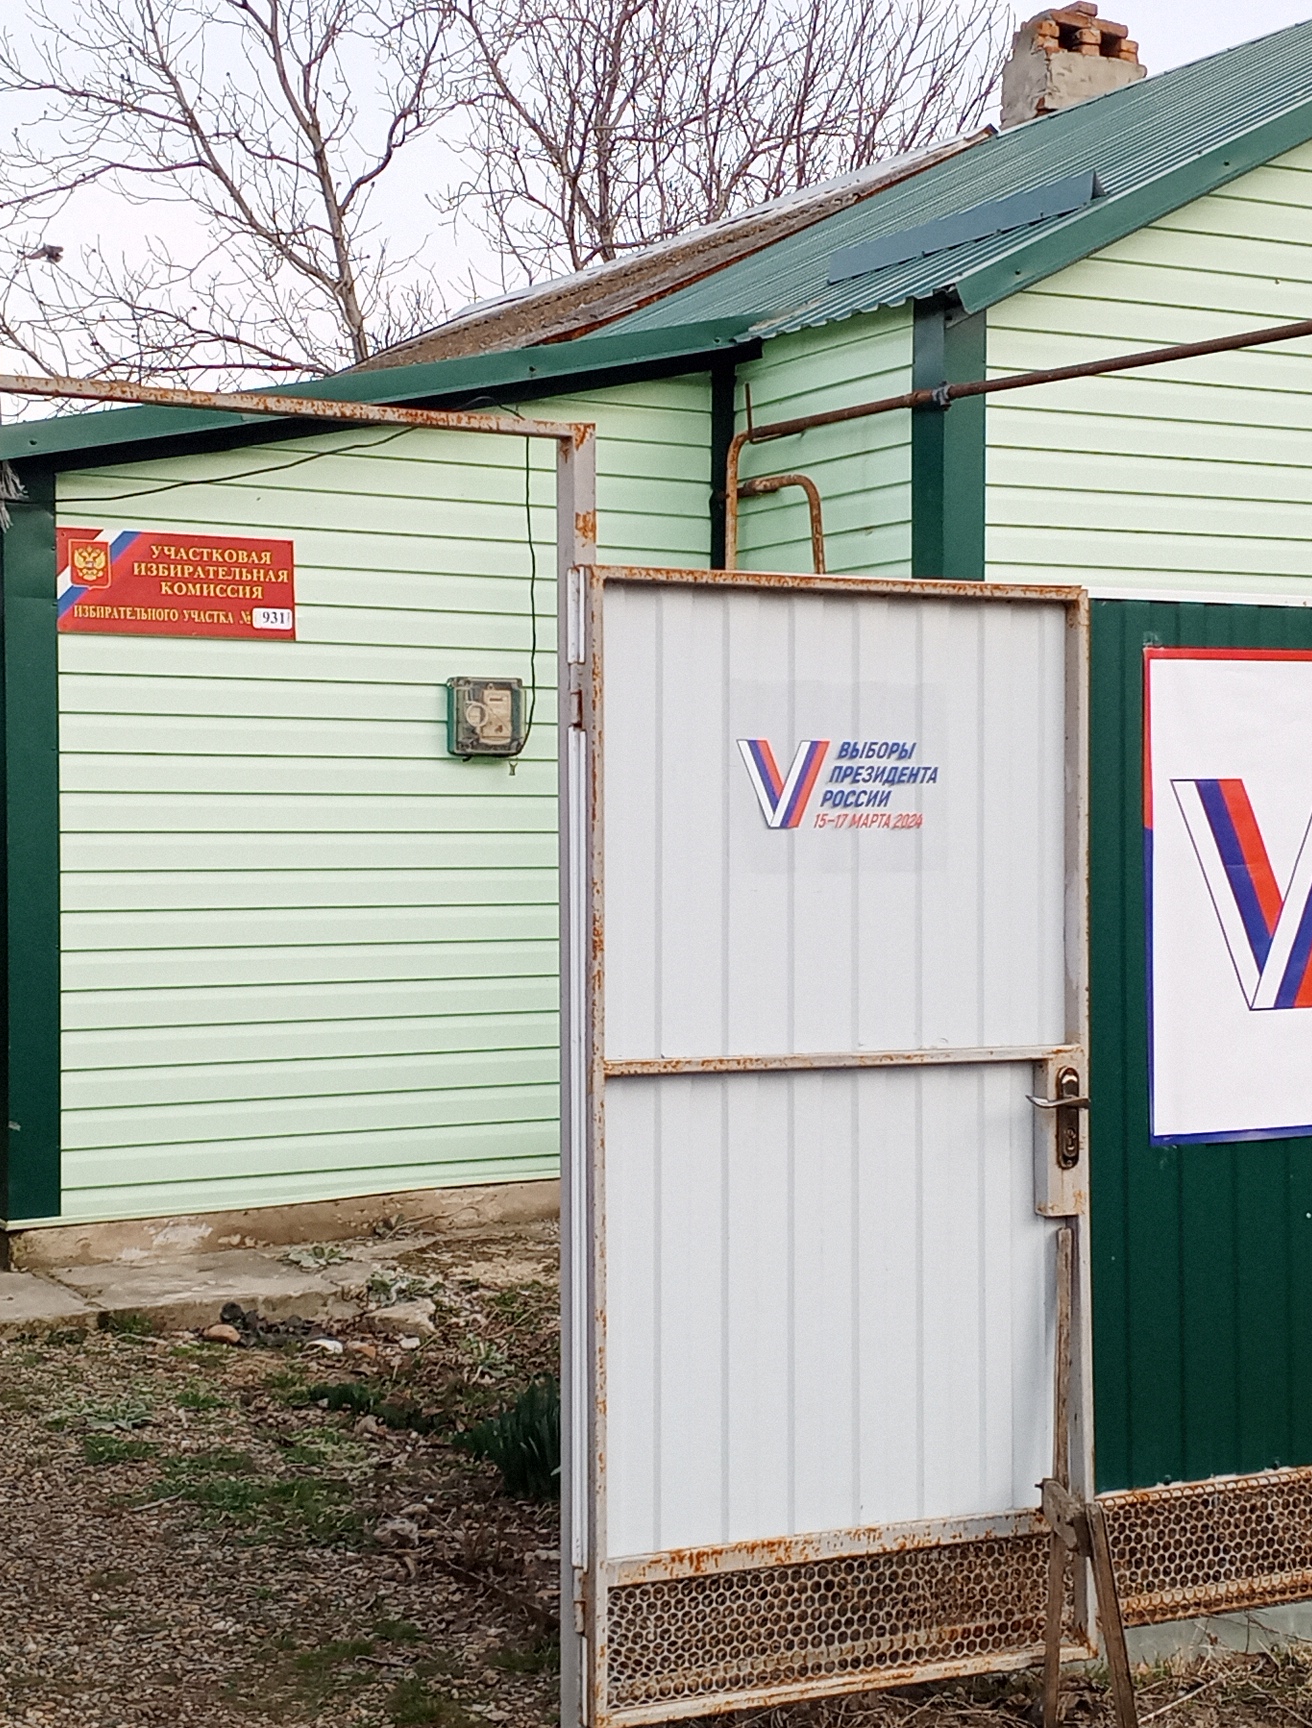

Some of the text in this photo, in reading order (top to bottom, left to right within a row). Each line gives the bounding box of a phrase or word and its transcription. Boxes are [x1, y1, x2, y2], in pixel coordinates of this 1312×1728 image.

[150, 545, 272, 565] УЧАСТКОВАЯ
[133, 562, 289, 583] ИЗБИРАТЕЛЬНАЯ
[160, 582, 264, 599] КОМИССИЯ
[74, 605, 178, 622] ИЗБИРАТЕЛЬНОГО
[183, 608, 234, 624] УЧАСТКА
[837, 741, 917, 759] ВЫБОРЫ
[829, 766, 939, 786] ПРЕЗИДЕНТА
[820, 790, 892, 807] РОССИИ
[848, 814, 891, 829] МАРТА
[891, 814, 923, 829] 2024
